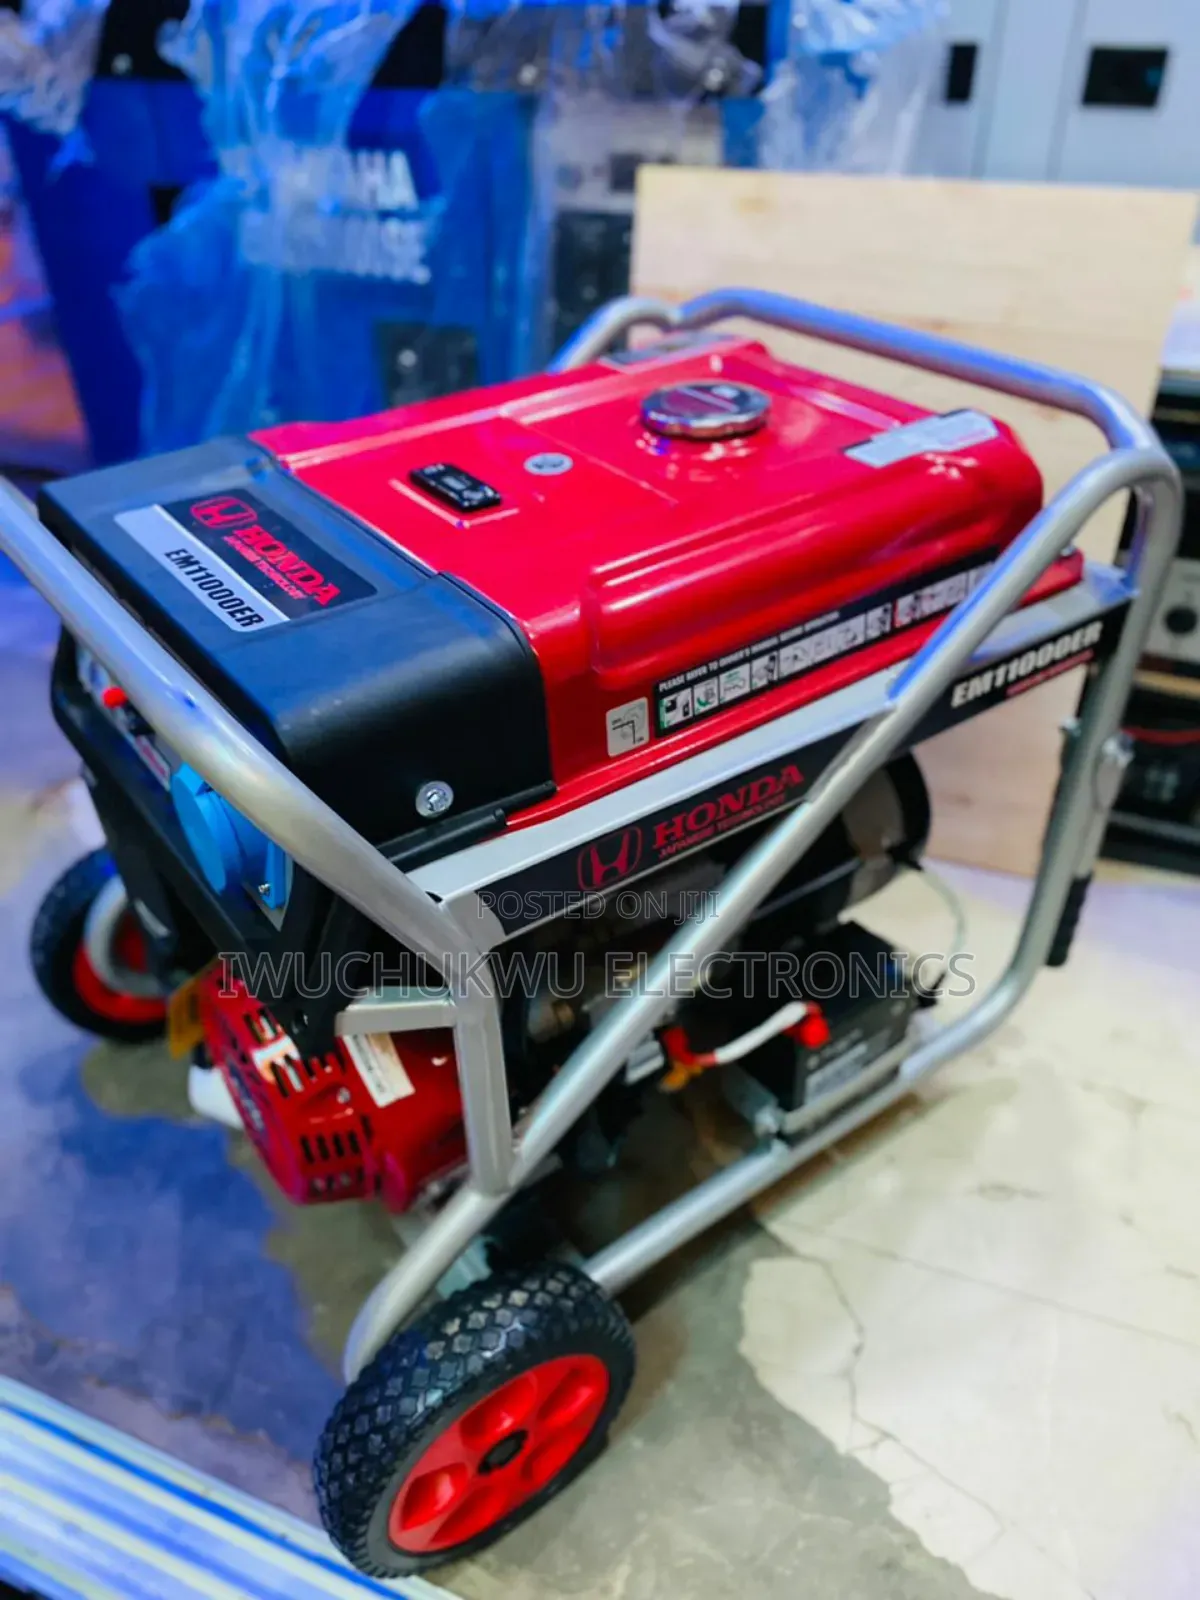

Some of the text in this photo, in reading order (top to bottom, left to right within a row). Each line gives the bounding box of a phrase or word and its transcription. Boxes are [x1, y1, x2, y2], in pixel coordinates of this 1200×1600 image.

[164, 548, 264, 628] EM11000ER
[233, 524, 341, 606] HONDA
[951, 620, 1103, 709] EM11000ER
[652, 764, 805, 850] HONDA
